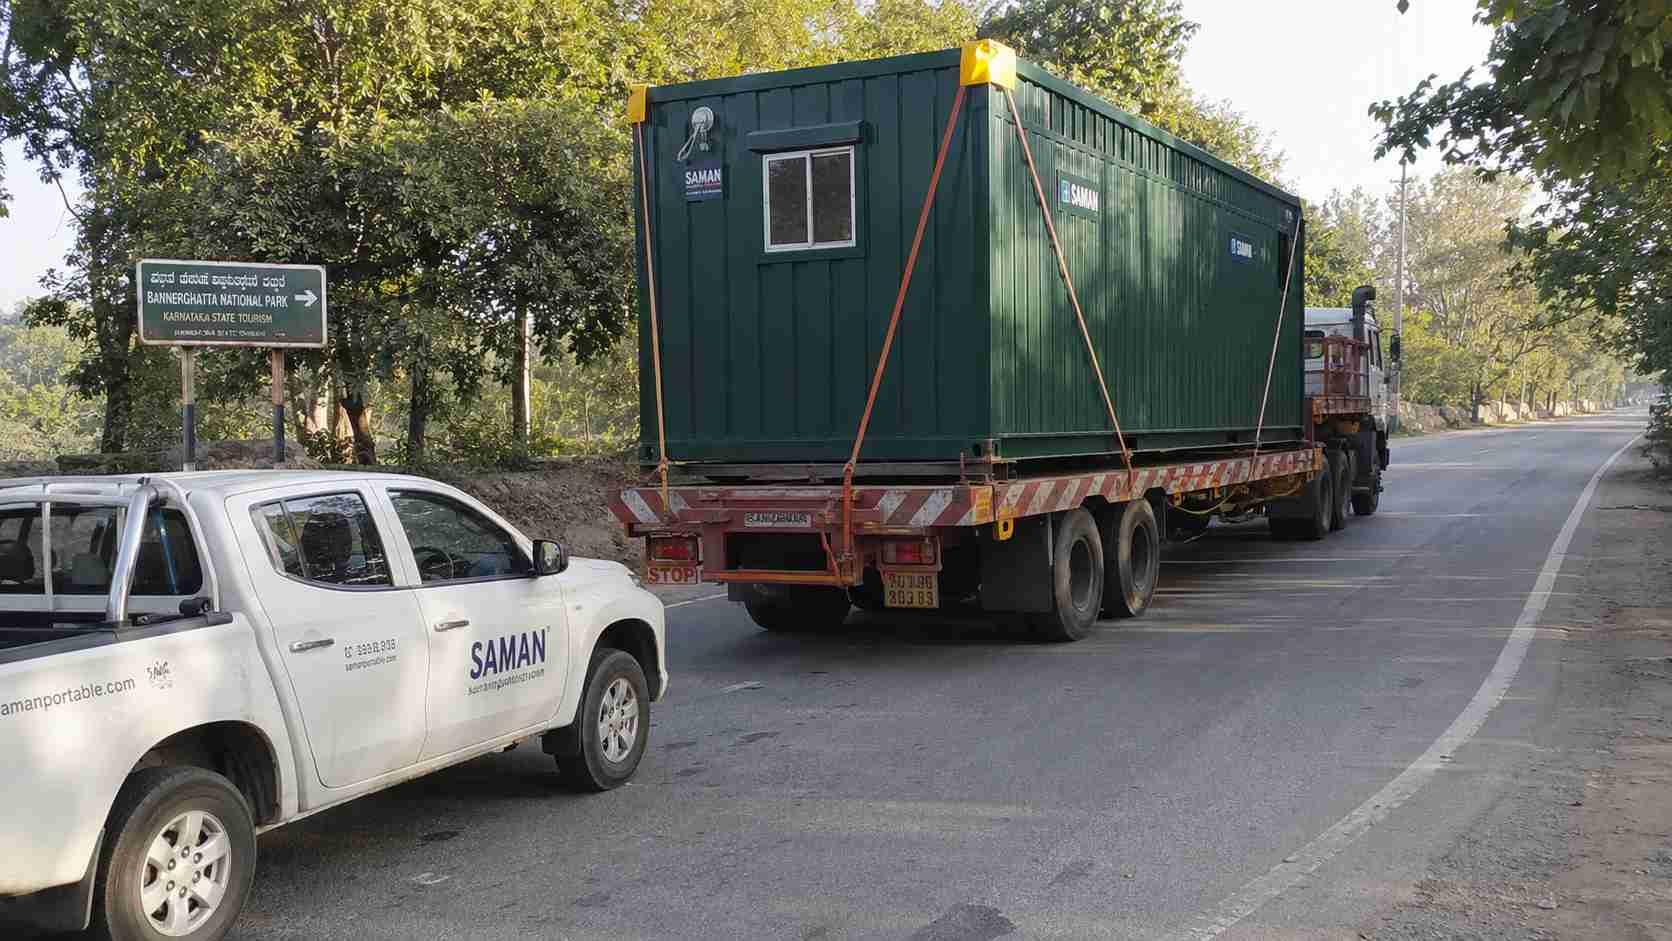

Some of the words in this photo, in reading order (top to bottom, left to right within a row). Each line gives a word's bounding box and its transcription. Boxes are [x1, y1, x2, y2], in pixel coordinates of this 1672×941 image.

[686, 168, 721, 185] SAMAN
[1071, 183, 1099, 212] SAMAN
[147, 290, 219, 307] BANNERGHATTA
[220, 294, 263, 308] NATIONAL
[264, 295, 289, 309] PARK
[163, 311, 210, 323] KARNATAKA
[211, 313, 235, 324] STATE
[238, 313, 273, 325] TOURISM
[649, 567, 695, 583] STOP
[470, 628, 545, 680] SAMAN
